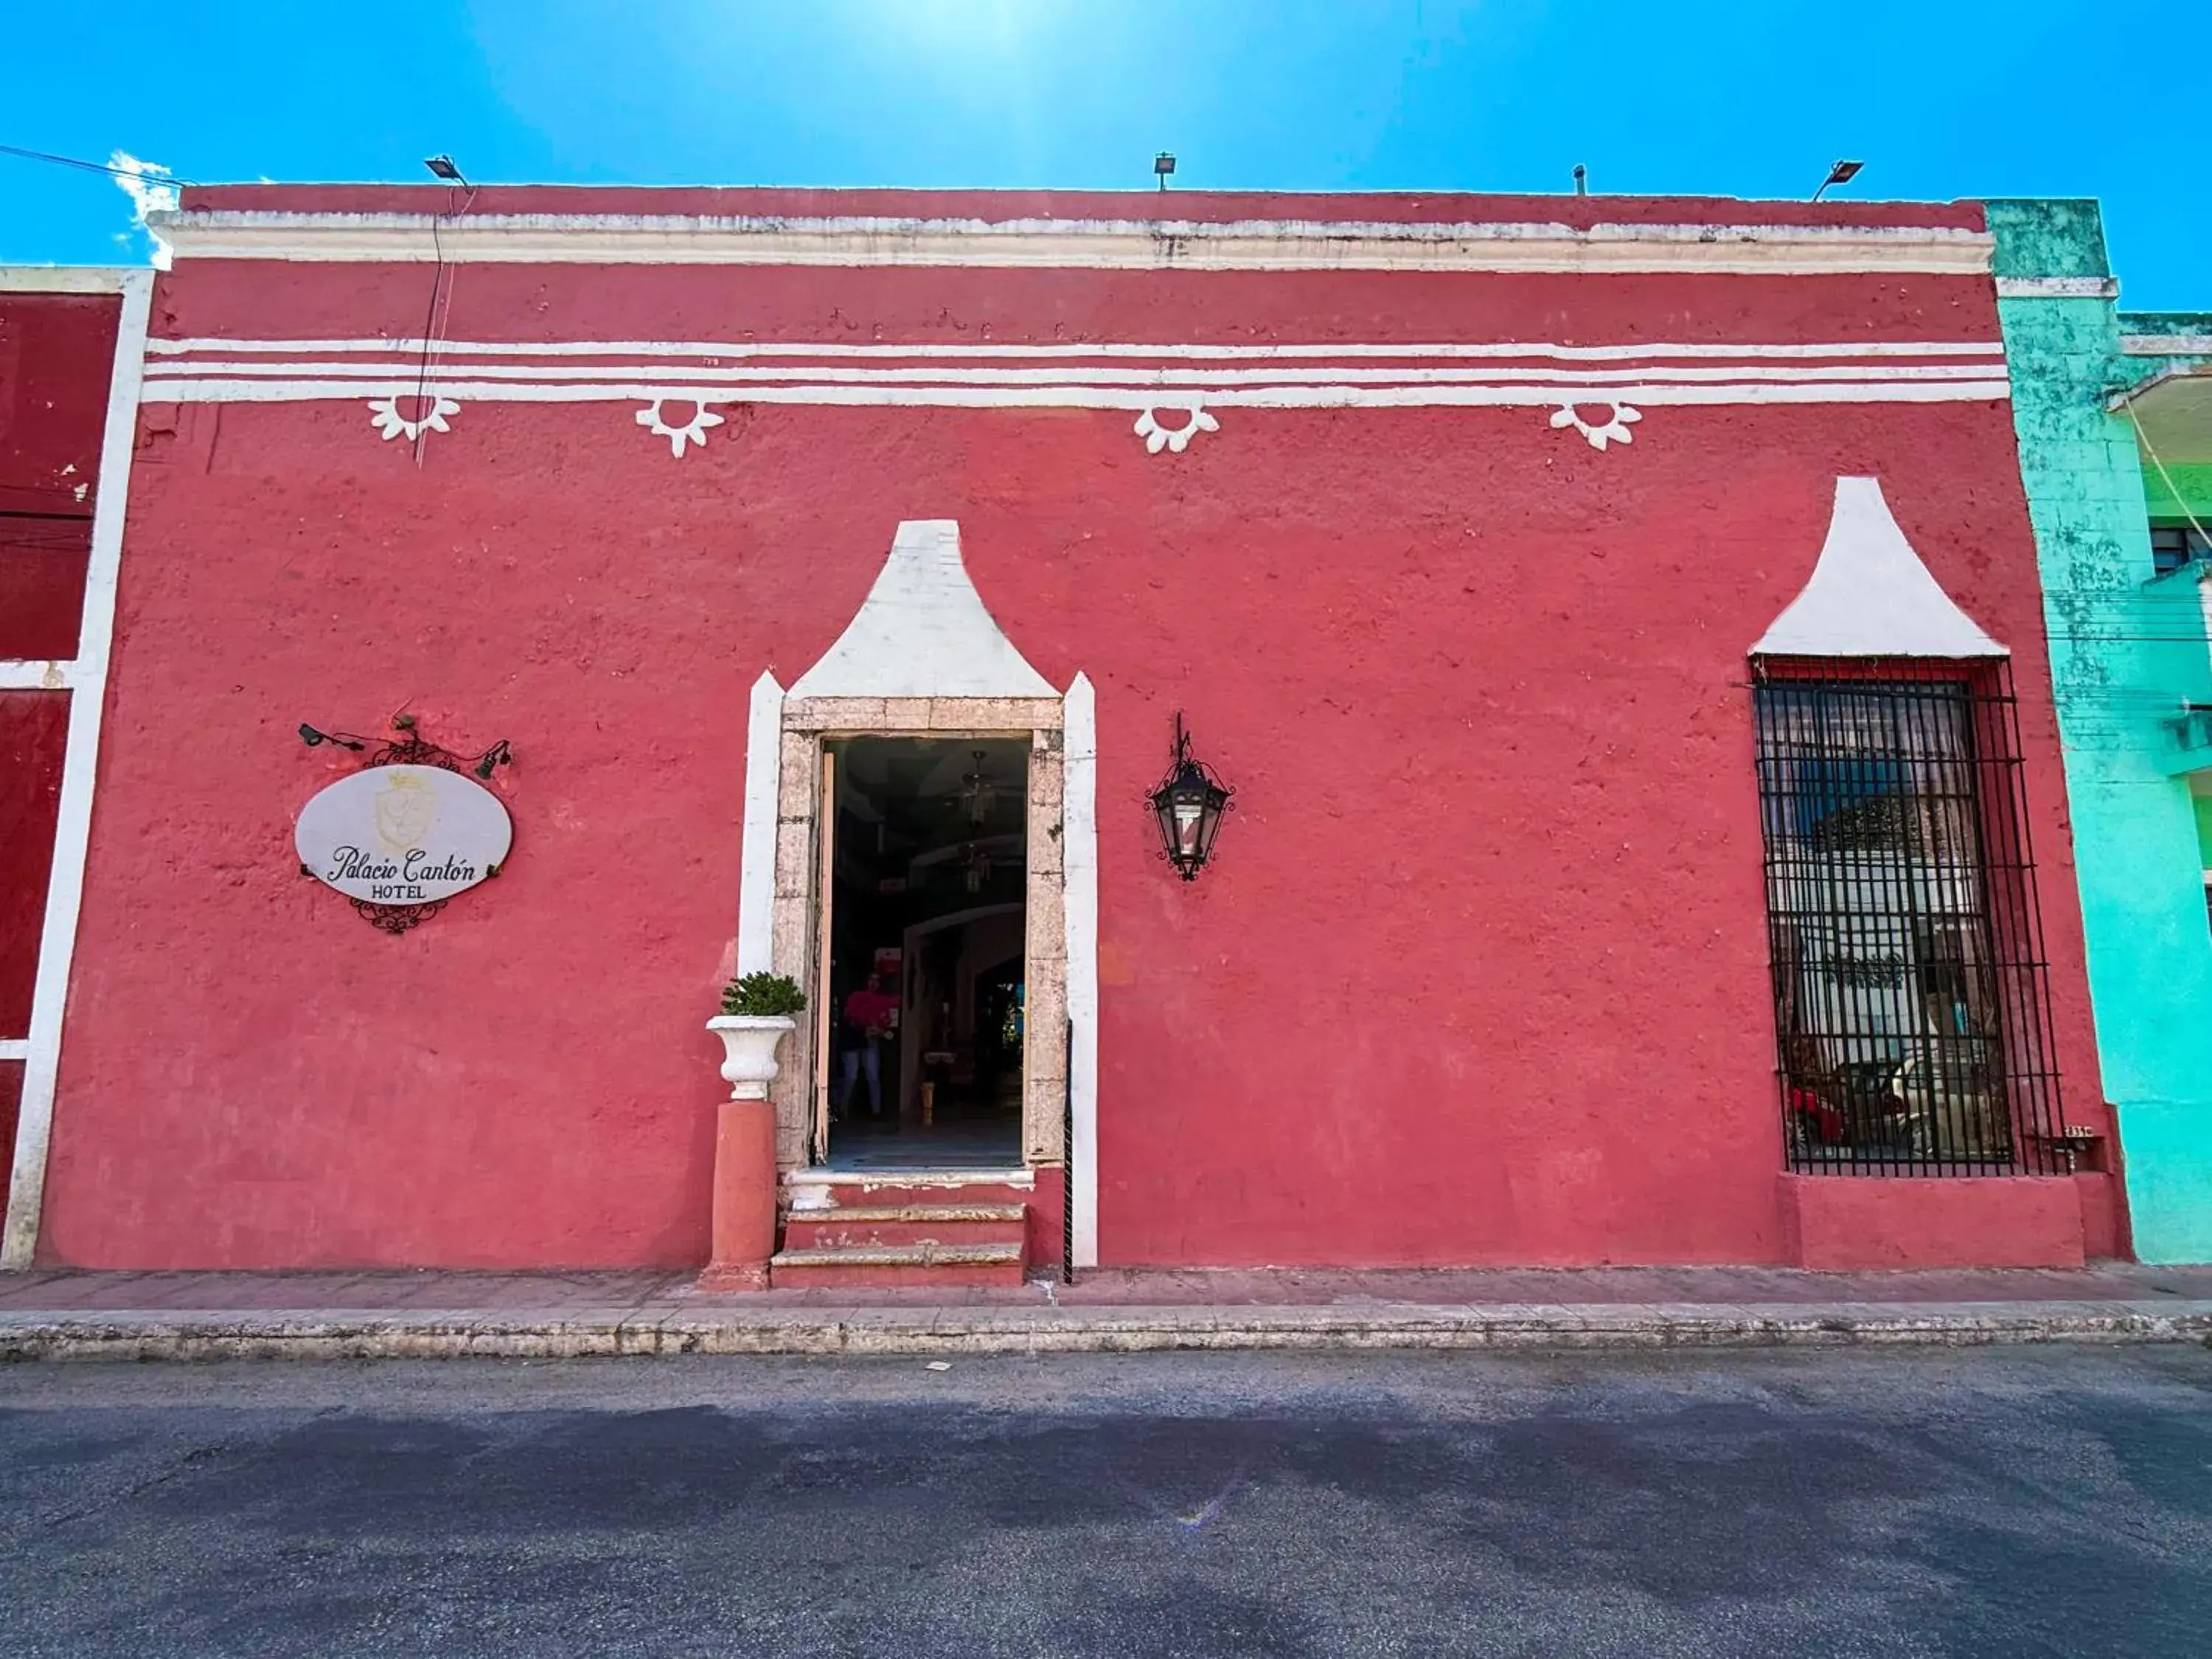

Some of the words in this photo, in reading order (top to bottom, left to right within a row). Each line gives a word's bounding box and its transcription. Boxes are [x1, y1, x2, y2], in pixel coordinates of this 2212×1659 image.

[327, 846, 398, 882] Palacio
[403, 848, 475, 883] Cantón
[372, 886, 426, 899] HOTEL
